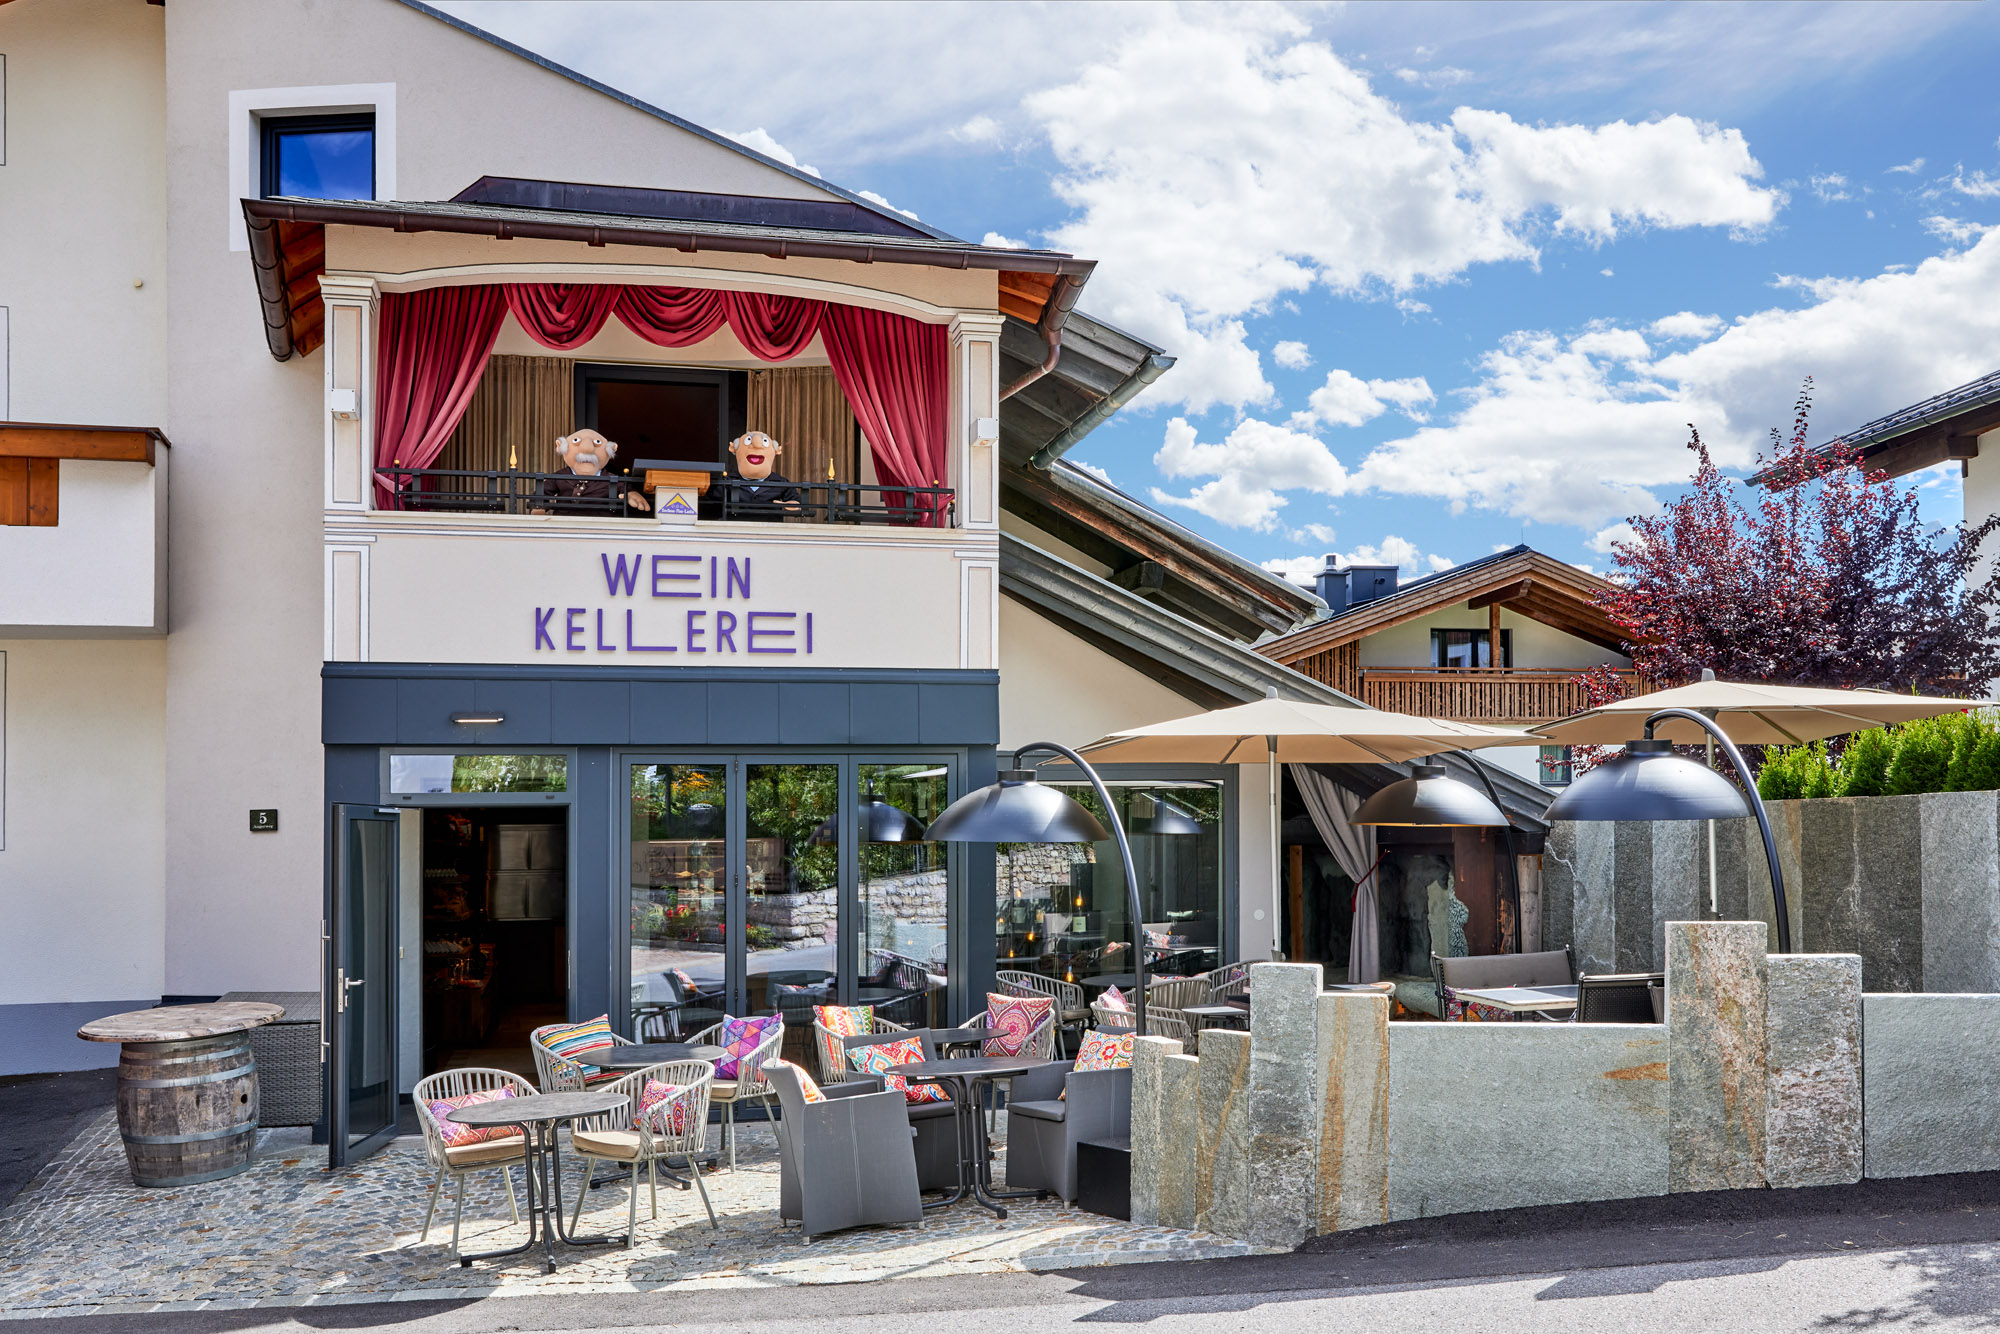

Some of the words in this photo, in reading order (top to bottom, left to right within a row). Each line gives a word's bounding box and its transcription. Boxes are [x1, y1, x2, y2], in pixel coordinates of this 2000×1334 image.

[601, 553, 750, 599] WEIN
[534, 607, 813, 654] KELLEREI
[259, 812, 267, 824] 5
